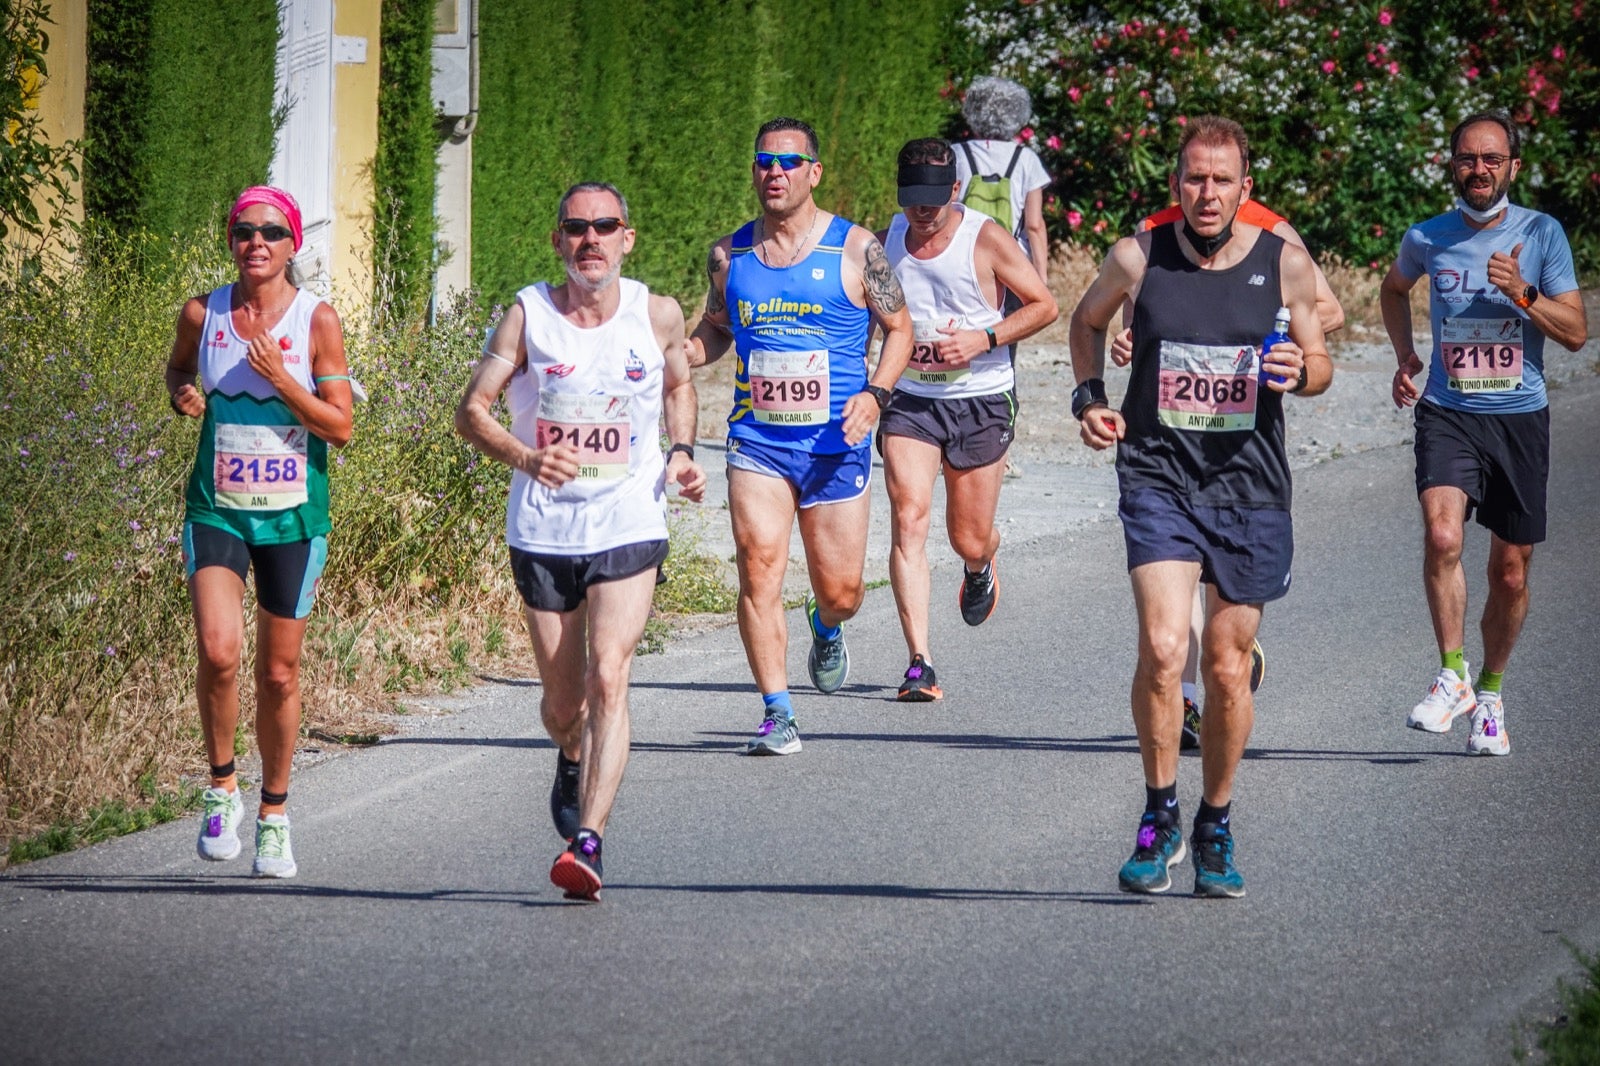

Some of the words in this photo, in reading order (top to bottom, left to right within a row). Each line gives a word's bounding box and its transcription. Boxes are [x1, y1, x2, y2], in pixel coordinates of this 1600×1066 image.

[757, 297, 823, 317] olimpo
[756, 315, 797, 324] deportes
[777, 328, 785, 336] &
[786, 328, 826, 337] RUNNING
[910, 345, 945, 364] 220
[1452, 346, 1514, 369] 2119
[920, 373, 947, 382] ANTONIO
[761, 380, 821, 402] 2199
[1174, 376, 1247, 404] 2068
[1483, 379, 1511, 390] MARINO
[784, 412, 812, 423] CARLOS
[1188, 415, 1225, 428] ANTONIO
[549, 426, 620, 453] 2140
[229, 457, 298, 483] 2158
[577, 466, 599, 478] ERTO
[251, 496, 268, 507] ANA
